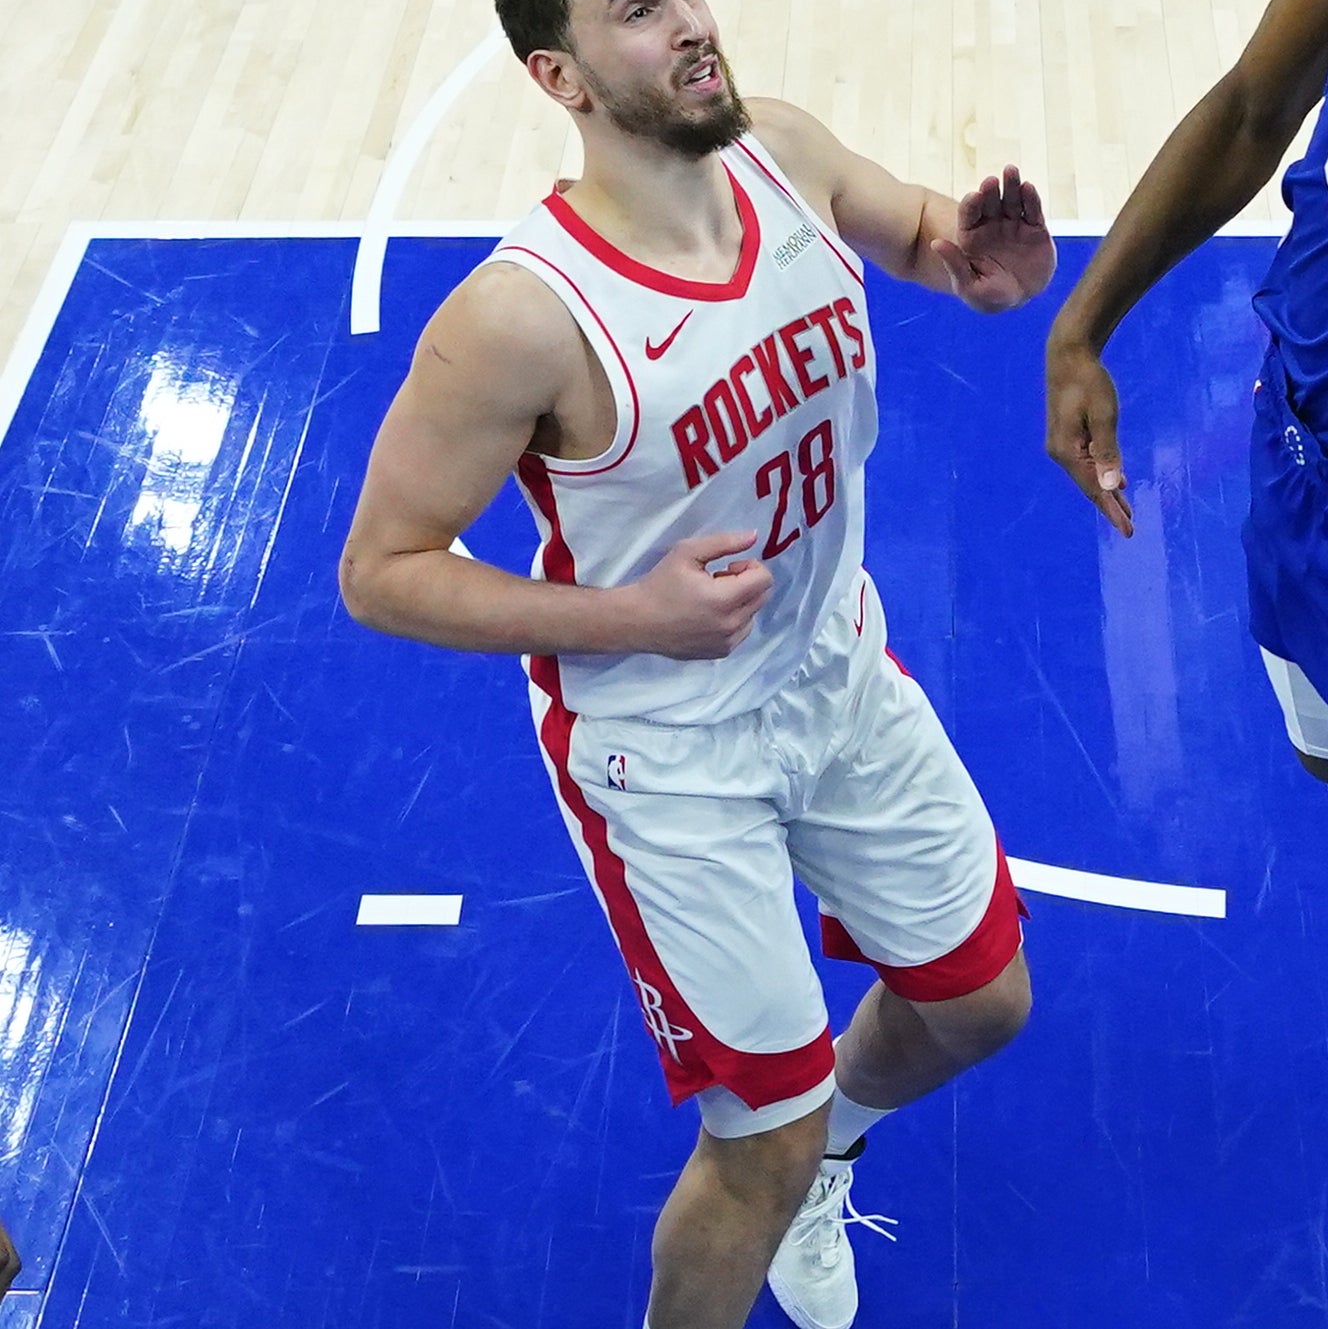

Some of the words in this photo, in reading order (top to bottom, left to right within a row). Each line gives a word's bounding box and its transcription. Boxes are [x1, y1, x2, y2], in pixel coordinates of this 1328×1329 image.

[772, 223, 813, 260] MEMORIAL
[776, 232, 817, 270] HERMANN
[671, 297, 867, 493] ROCKETS
[755, 420, 837, 560] 28
